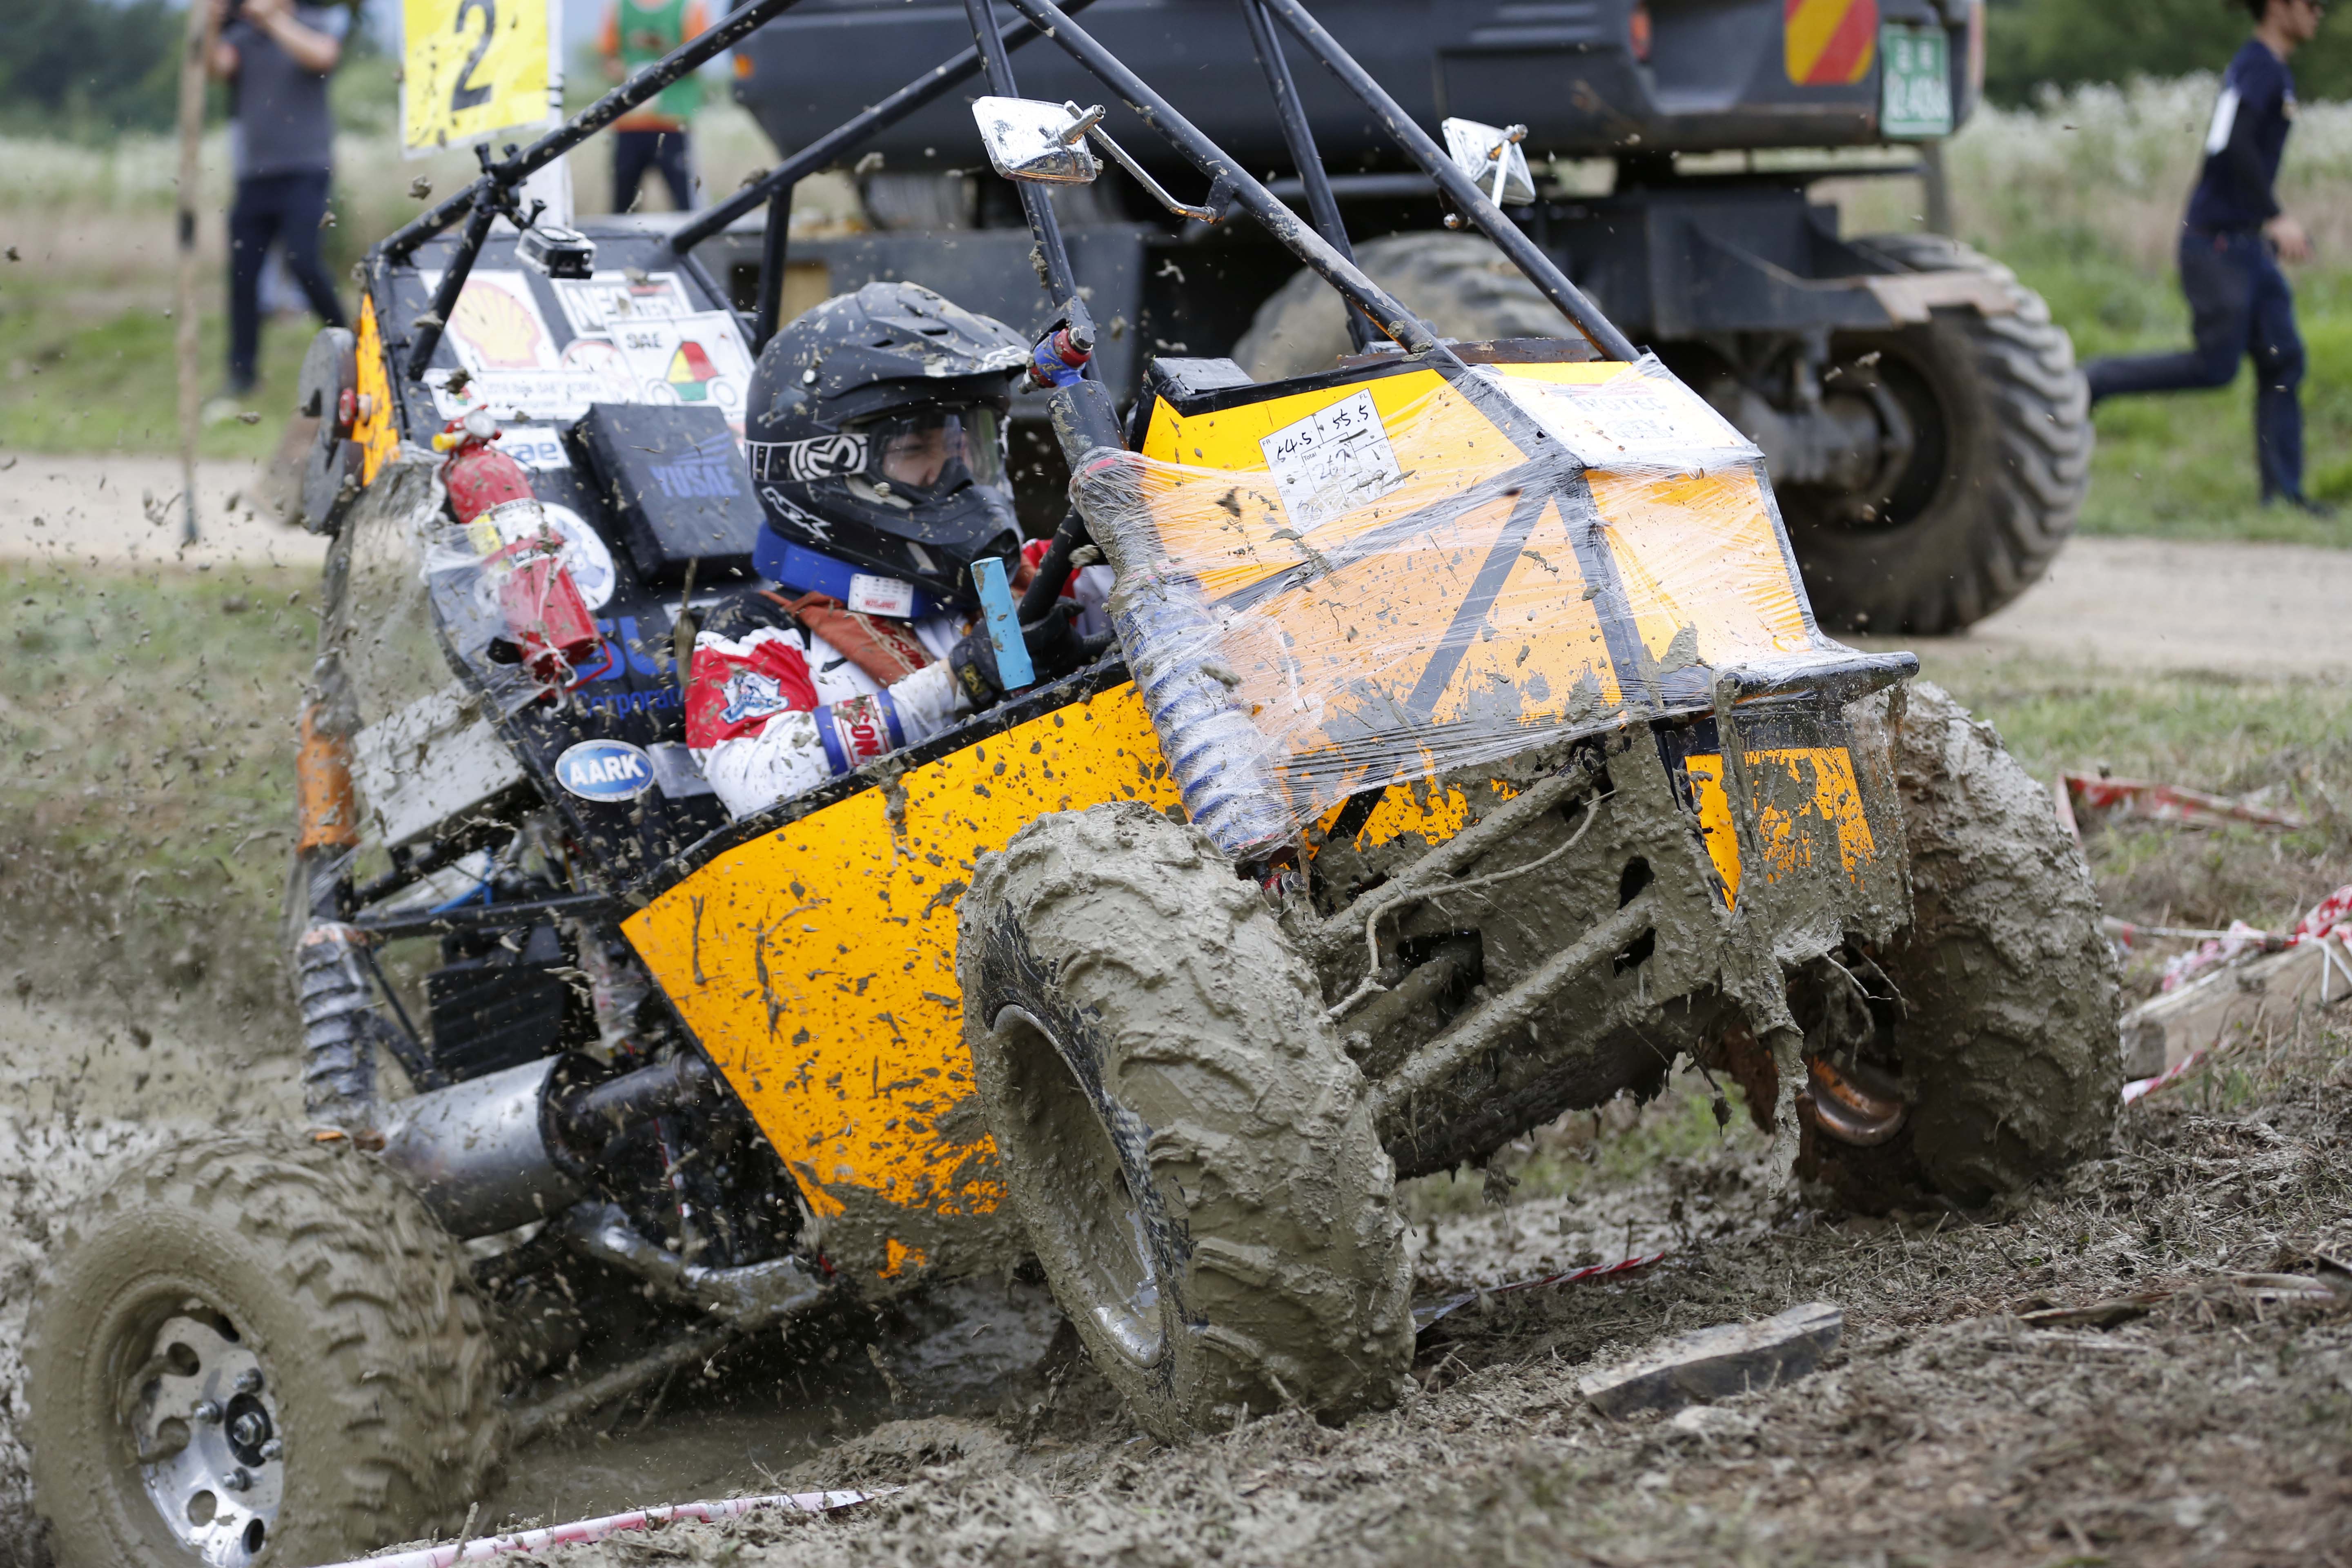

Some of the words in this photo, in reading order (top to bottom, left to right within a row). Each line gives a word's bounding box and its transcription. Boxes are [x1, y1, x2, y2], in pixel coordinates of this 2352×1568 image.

[451, 0, 495, 111] 2
[626, 332, 663, 350] SAE
[1333, 405, 1368, 430] 55.5
[1277, 432, 1312, 463] 54.5
[1303, 451, 1317, 461] Total
[1312, 449, 1347, 479] 267
[649, 465, 741, 498] YUSAE
[575, 681, 683, 721] Corporat
[570, 753, 645, 786] AARK
